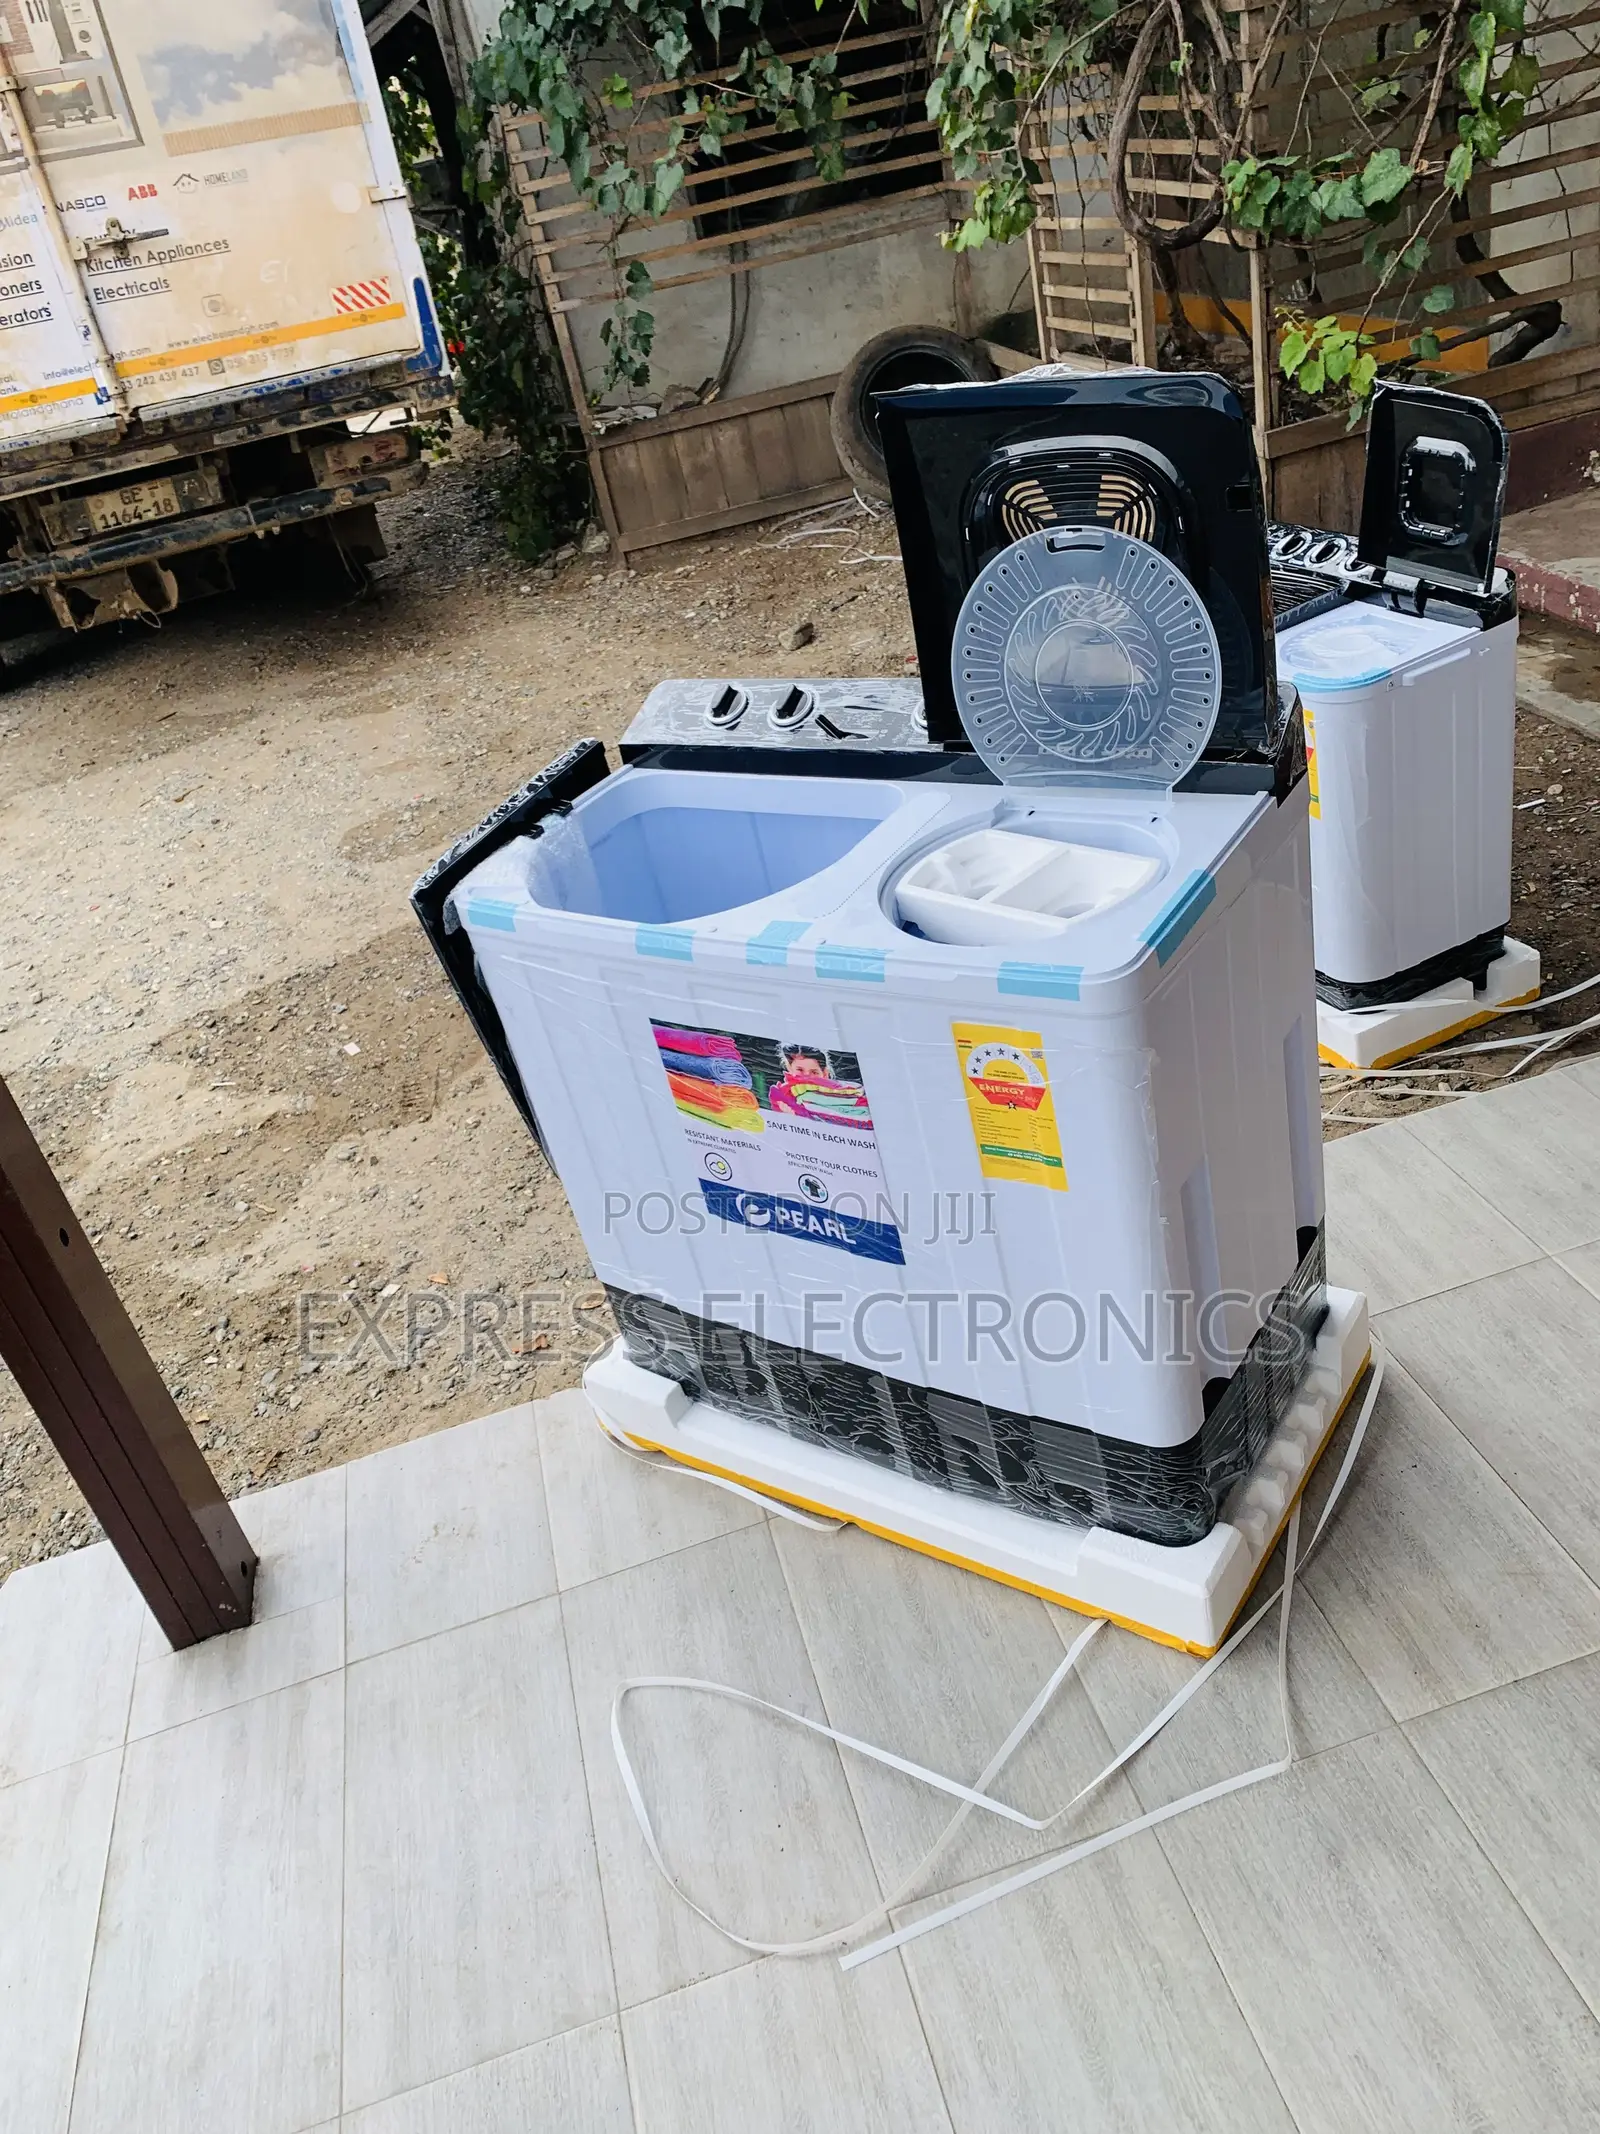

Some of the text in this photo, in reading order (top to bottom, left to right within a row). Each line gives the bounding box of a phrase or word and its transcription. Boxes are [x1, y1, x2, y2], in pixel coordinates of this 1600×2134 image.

[128, 183, 158, 201] ABB
[0, 252, 34, 268] sion
[86, 239, 230, 273] Kitchen Appliances
[93, 277, 171, 300] Electricals
[136, 375, 156, 388] 242
[181, 366, 199, 378] 437
[120, 486, 144, 506] GE
[99, 498, 174, 529] 1164-18
[978, 1082, 1025, 1096] ENERGY
[684, 1128, 761, 1152] RESISTANT MATERIALS
[767, 1120, 876, 1150] SAVE TIME IN EACH WASH
[785, 1151, 878, 1178] PROTECT YOUR CLOTHES
[775, 1206, 857, 1245] PEARL
